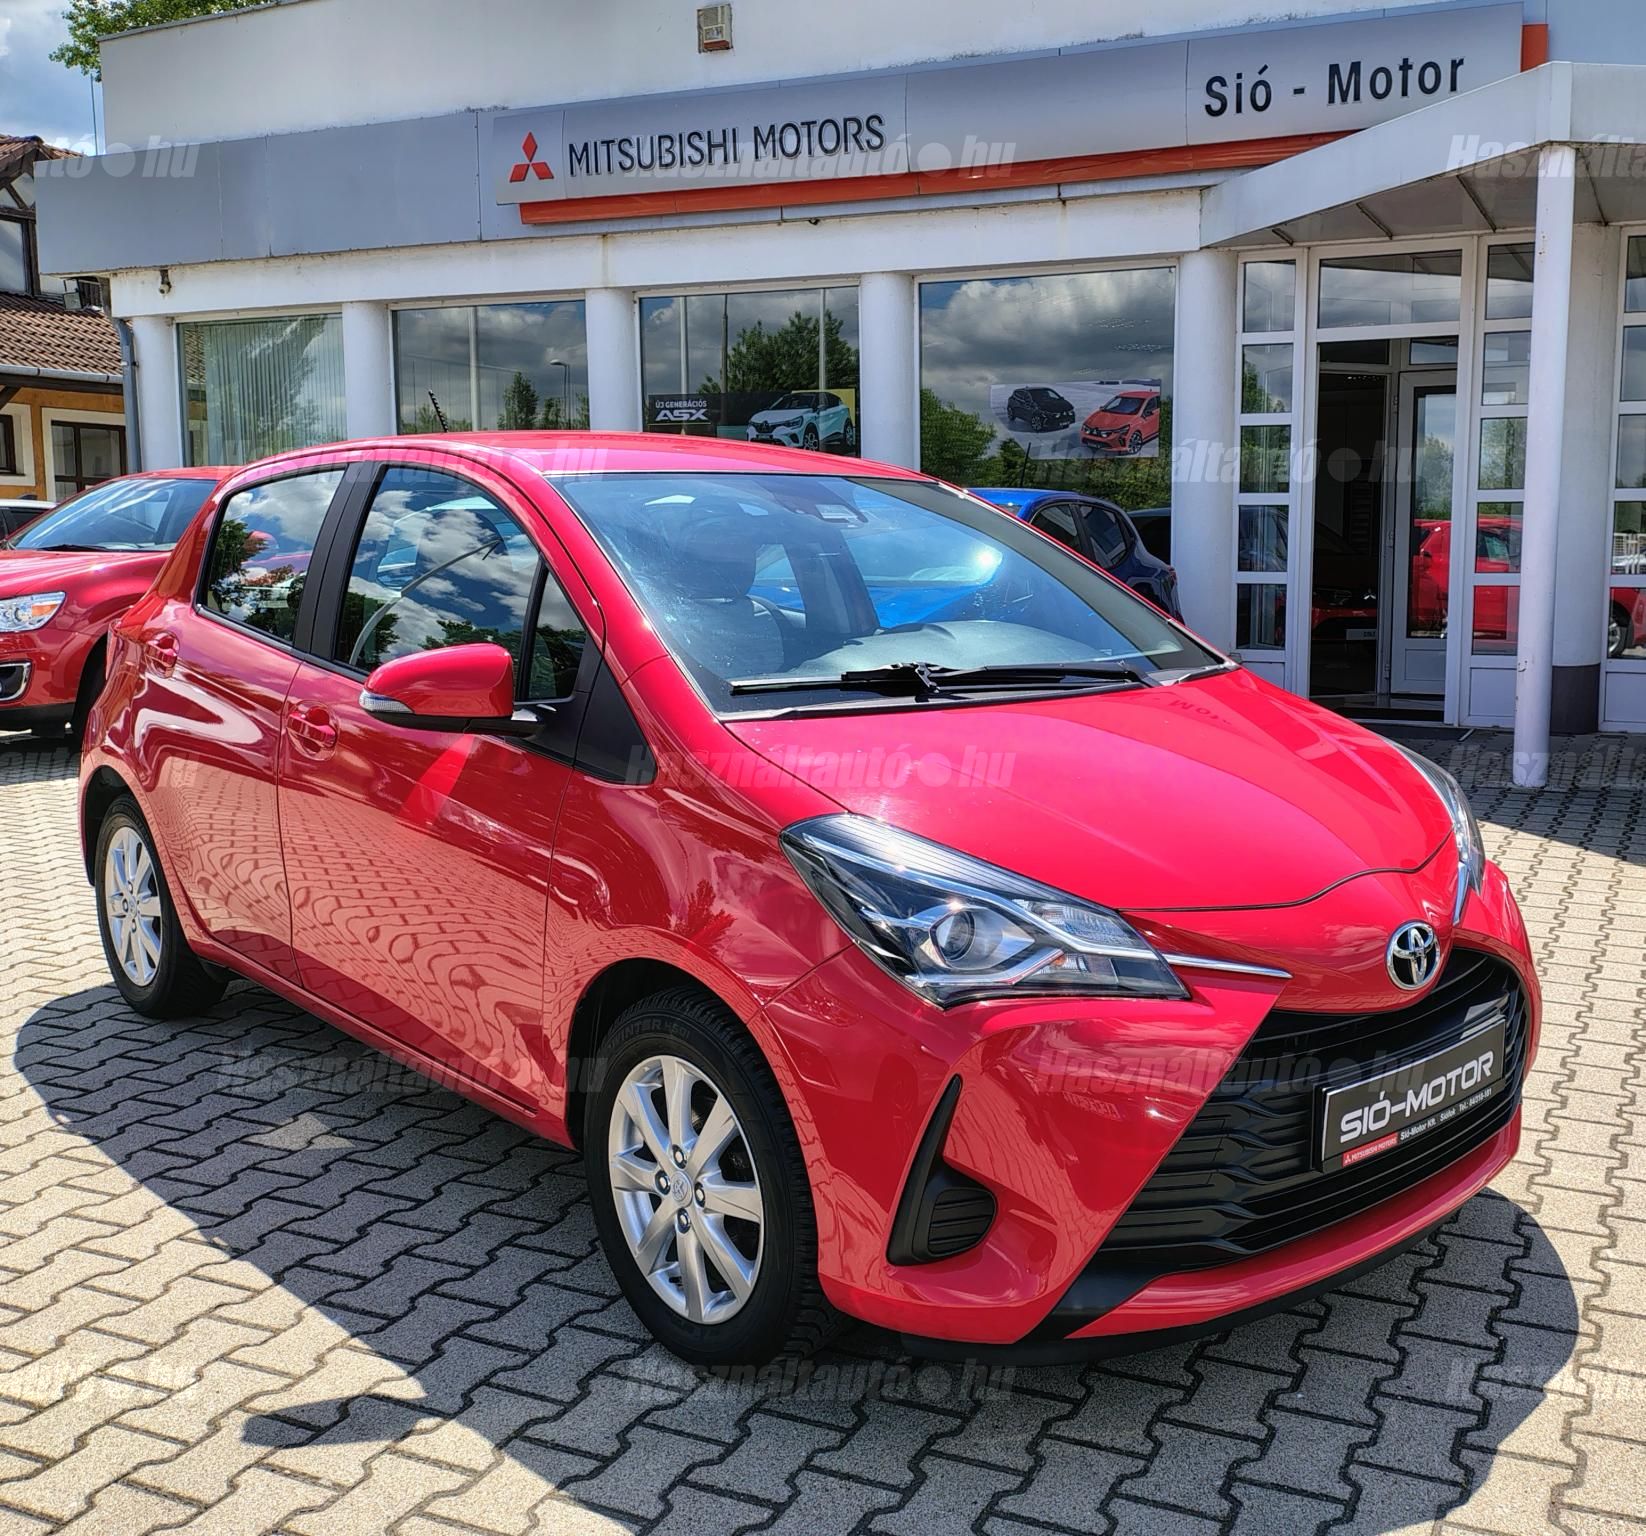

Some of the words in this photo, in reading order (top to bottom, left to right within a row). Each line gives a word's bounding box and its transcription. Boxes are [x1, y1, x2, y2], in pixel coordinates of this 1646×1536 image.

[1204, 64, 1272, 117] Sió
[1327, 57, 1464, 106] Motor
[569, 126, 739, 177] MITSUBISHI
[753, 114, 886, 162] MOTORS
[655, 408, 709, 421] ASX
[1340, 1050, 1494, 1143] SIÓ-MOTOR
